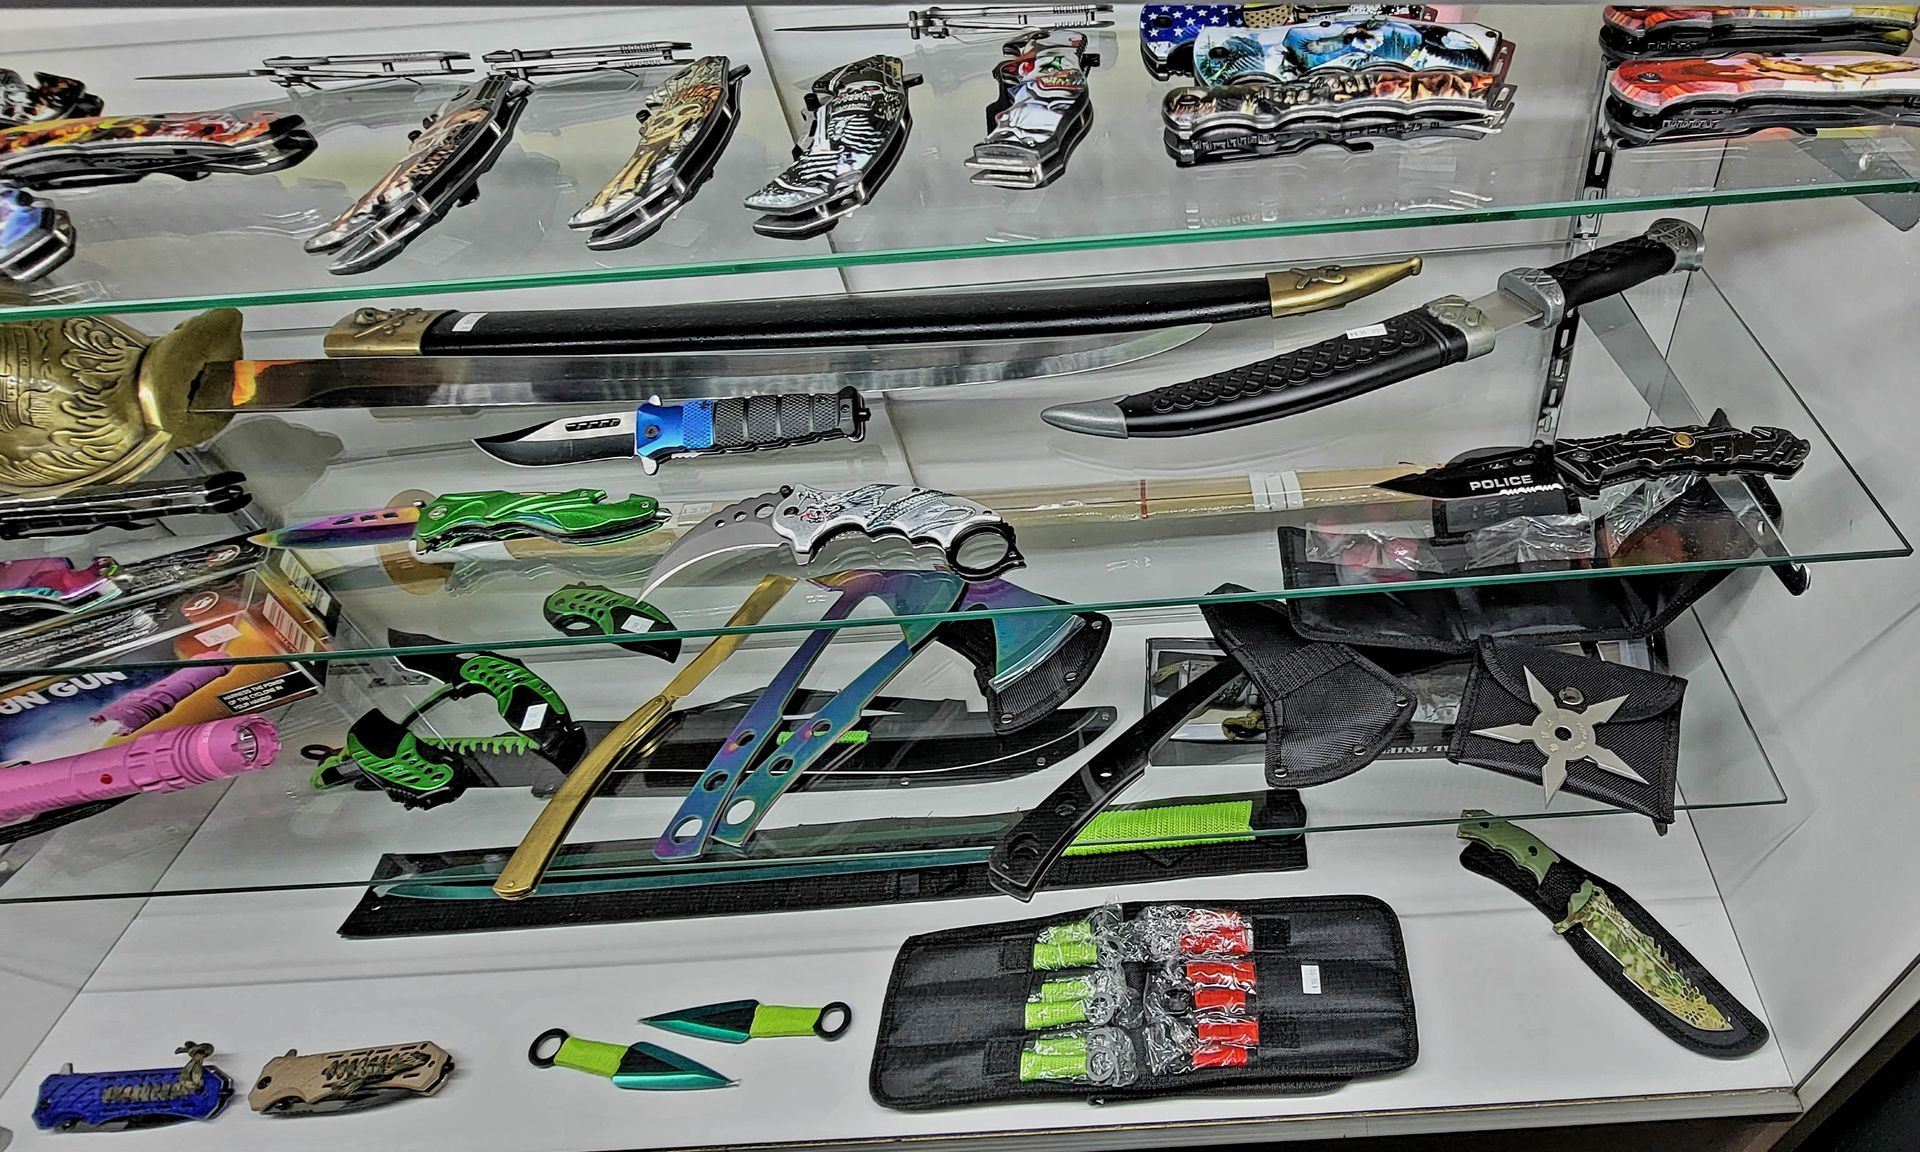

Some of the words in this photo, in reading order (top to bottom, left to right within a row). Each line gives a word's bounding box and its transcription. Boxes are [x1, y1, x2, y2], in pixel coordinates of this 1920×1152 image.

[1469, 474, 1534, 491] POLICE
[48, 671, 128, 697] GUN
[263, 678, 286, 688] POWER
[249, 687, 276, 699] CYCLONE
[233, 702, 250, 710] YOUR
